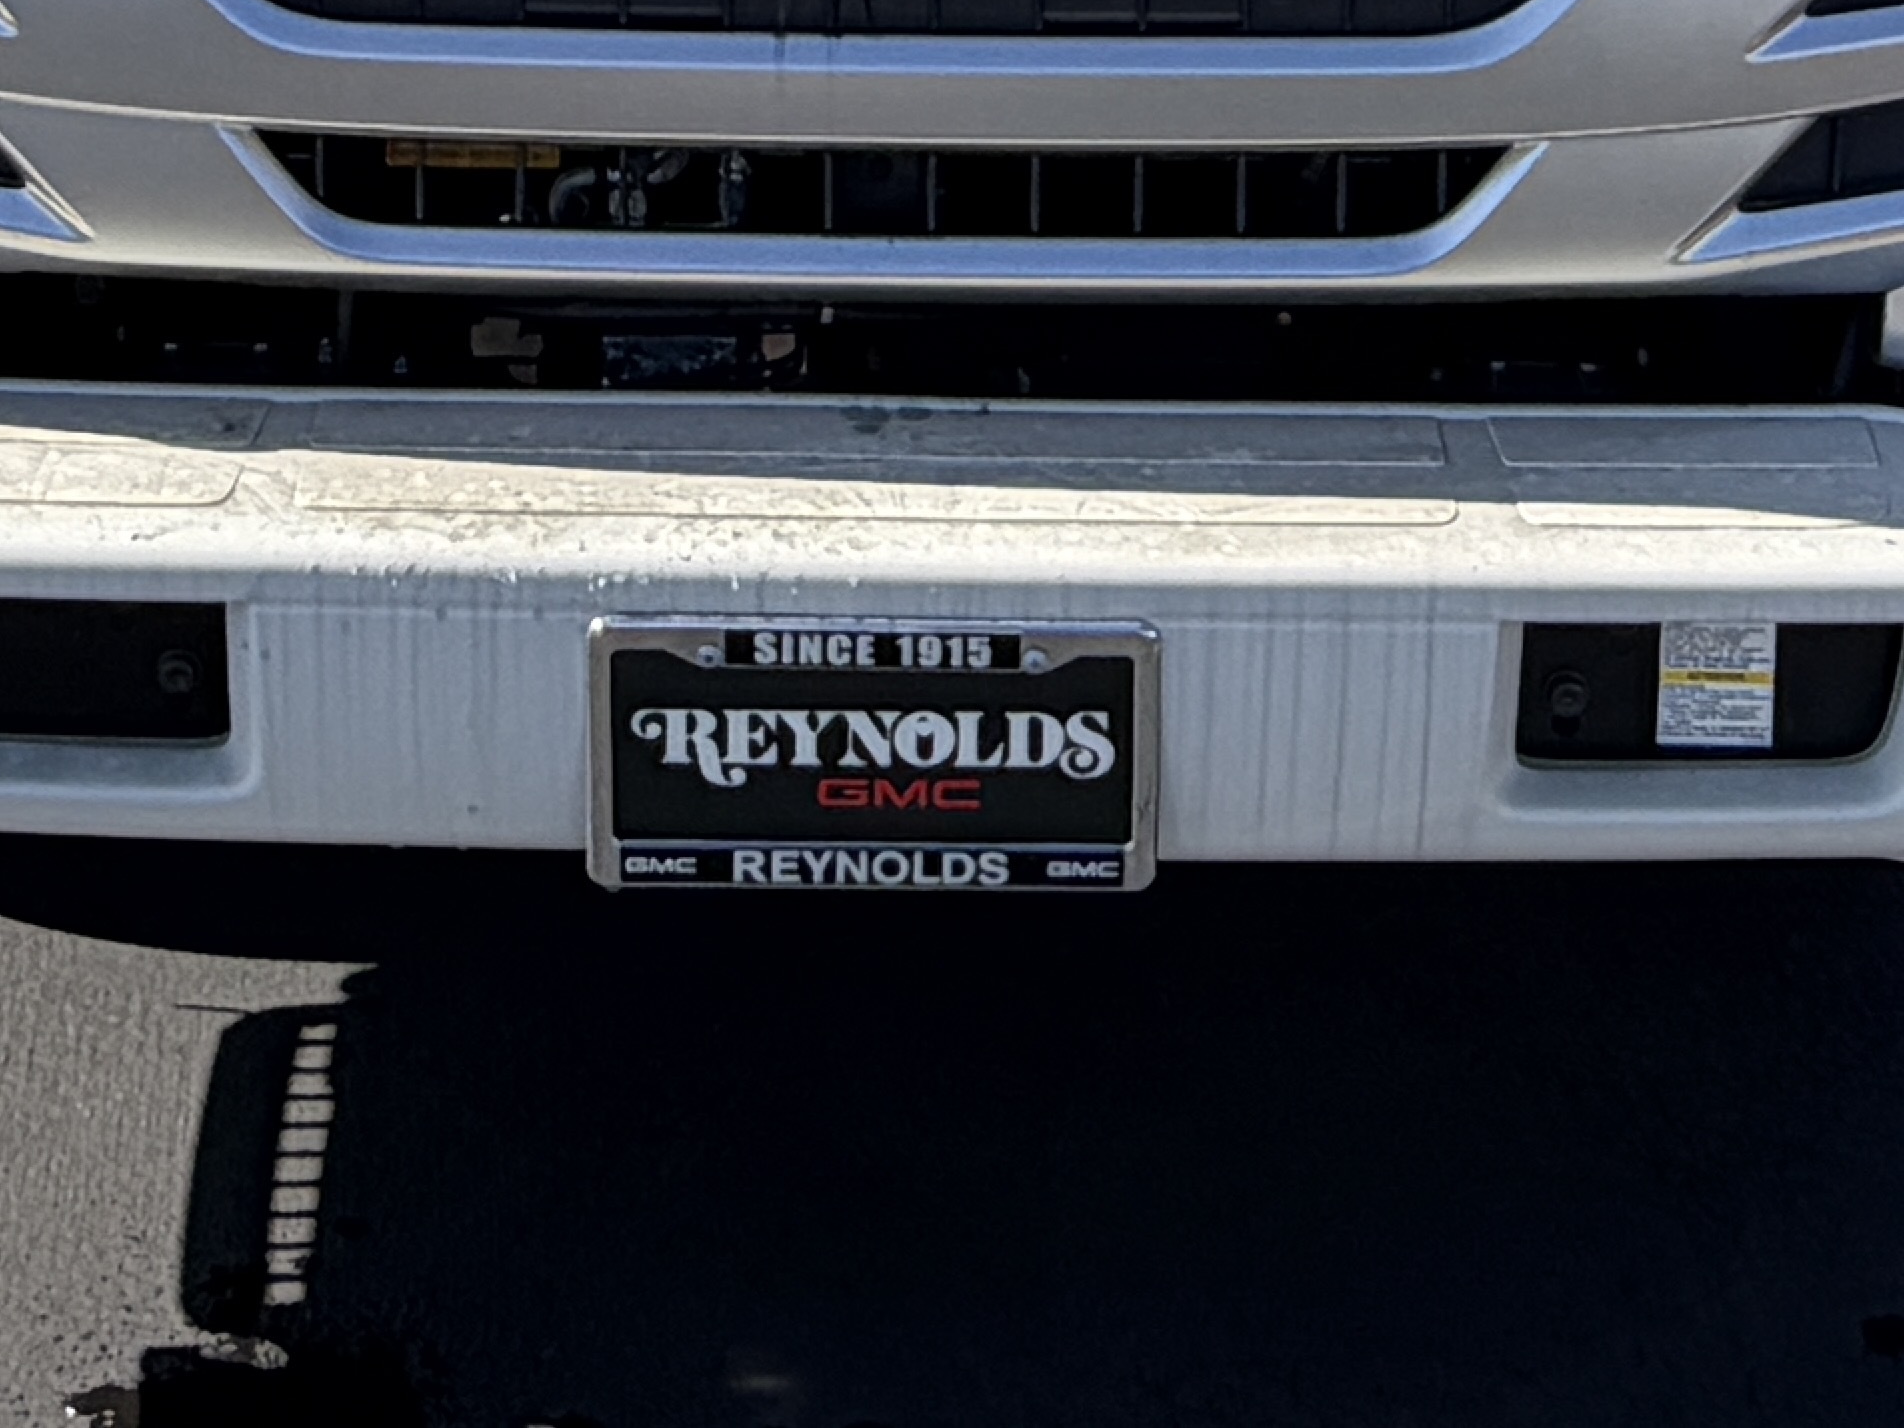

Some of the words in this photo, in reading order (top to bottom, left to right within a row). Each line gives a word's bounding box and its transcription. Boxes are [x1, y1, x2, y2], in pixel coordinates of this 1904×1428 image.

[753, 632, 876, 667] SINCE
[897, 635, 992, 668] 1915
[630, 708, 1116, 786] REYNOLDS
[817, 779, 982, 809] GMC
[624, 856, 697, 875] GMC
[733, 851, 1010, 885] REYNOLDS
[1047, 860, 1120, 878] GMC
